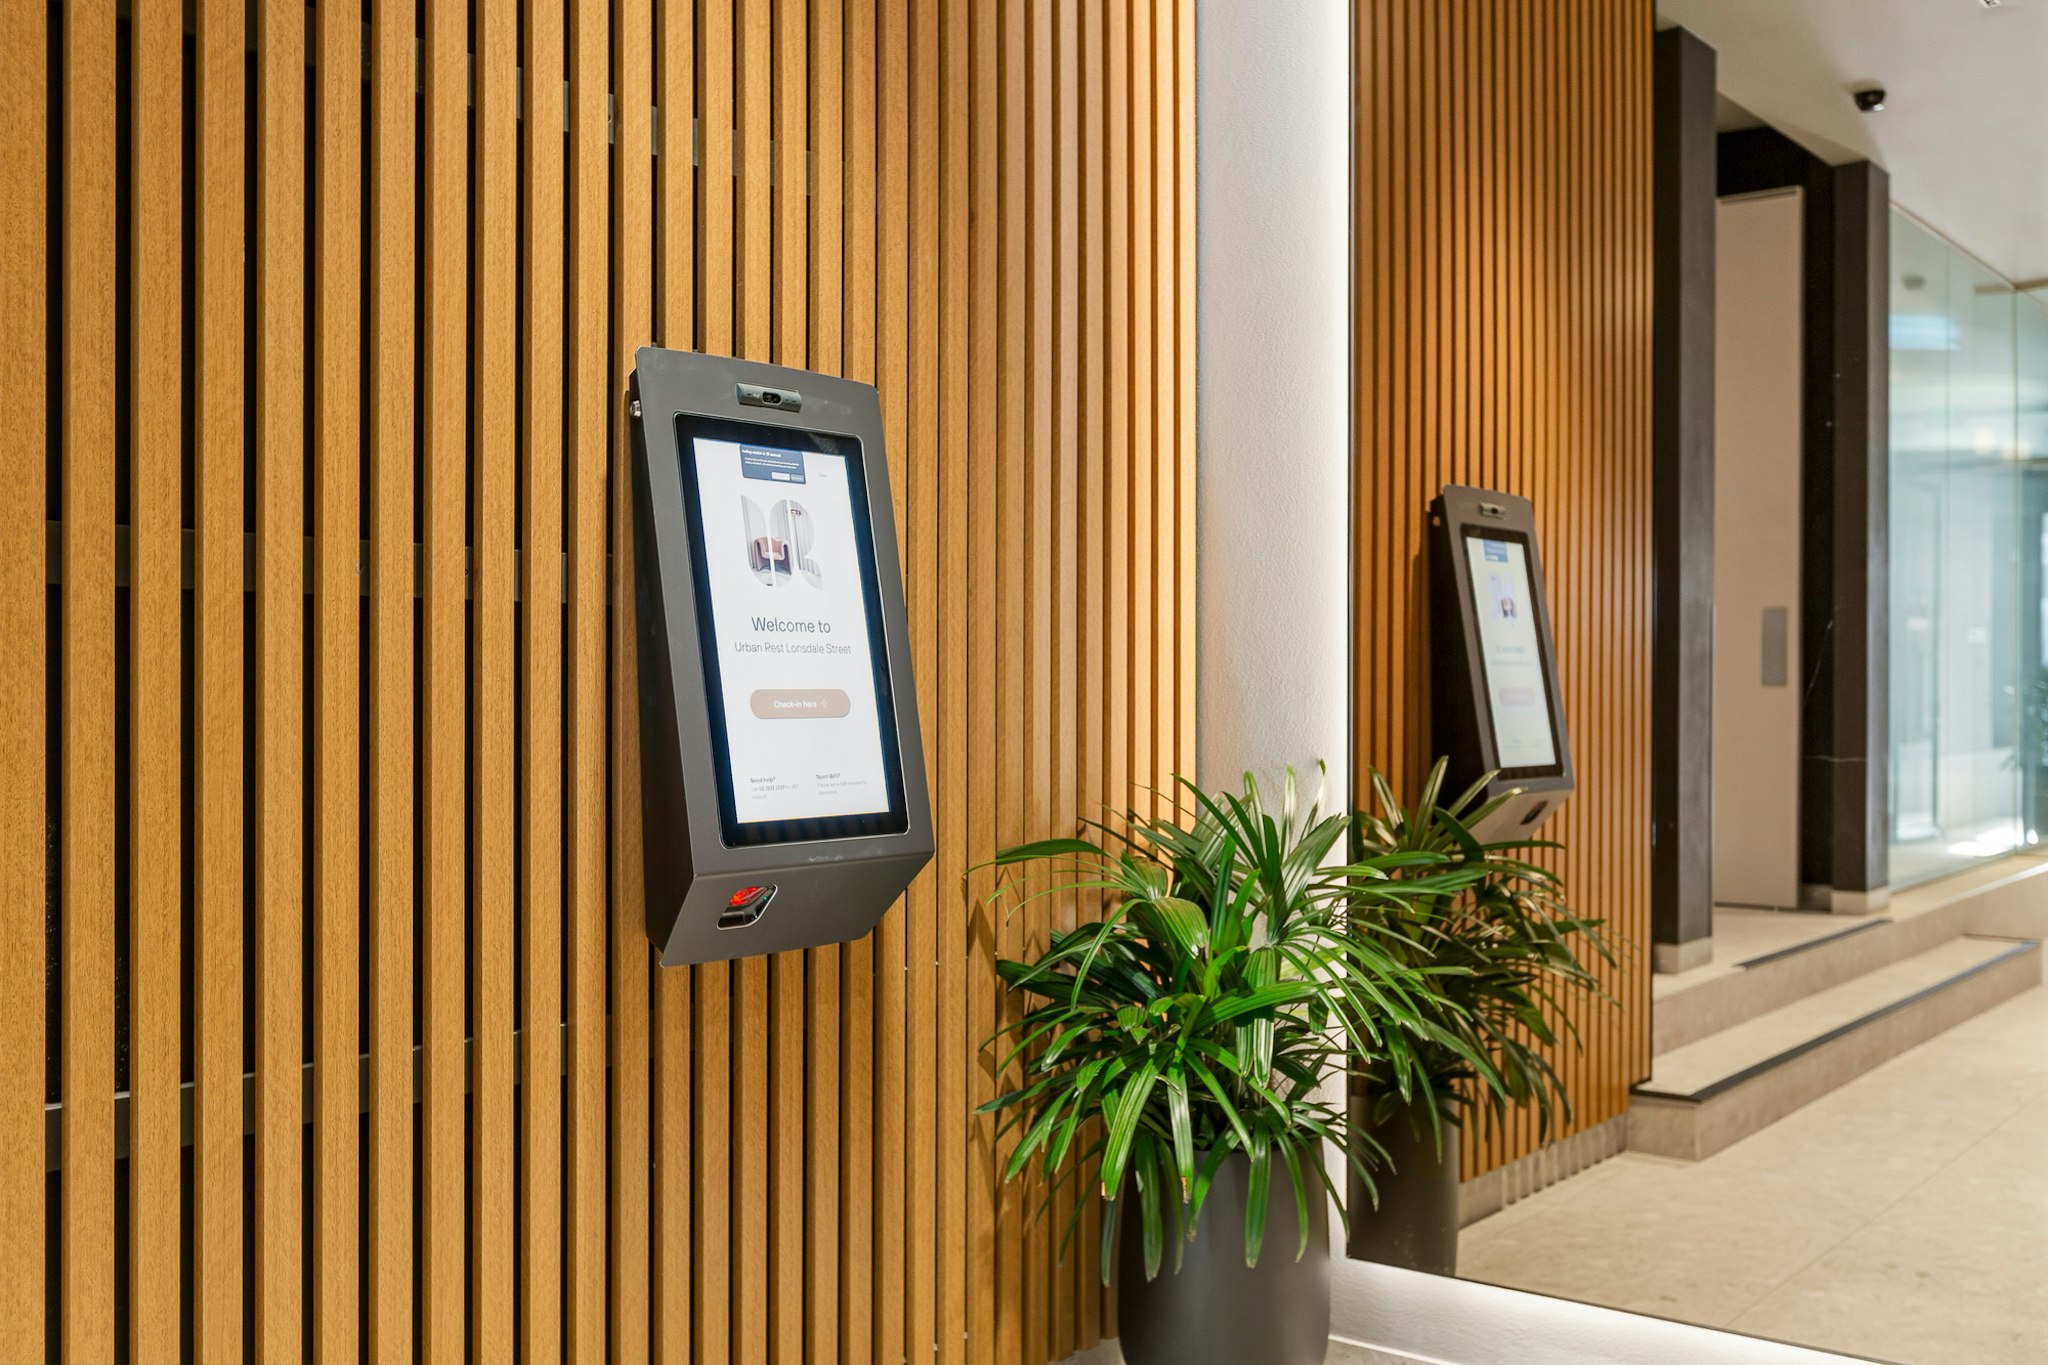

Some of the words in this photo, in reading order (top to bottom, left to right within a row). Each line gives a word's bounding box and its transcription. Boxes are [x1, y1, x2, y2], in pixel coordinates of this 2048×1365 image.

[751, 616, 815, 633] Welcome
[818, 619, 831, 633] to
[734, 641, 763, 653] Urban
[764, 642, 784, 653] Rest
[786, 643, 825, 654] Lonsdale
[825, 643, 852, 655] Street
[773, 700, 803, 709] Check-in
